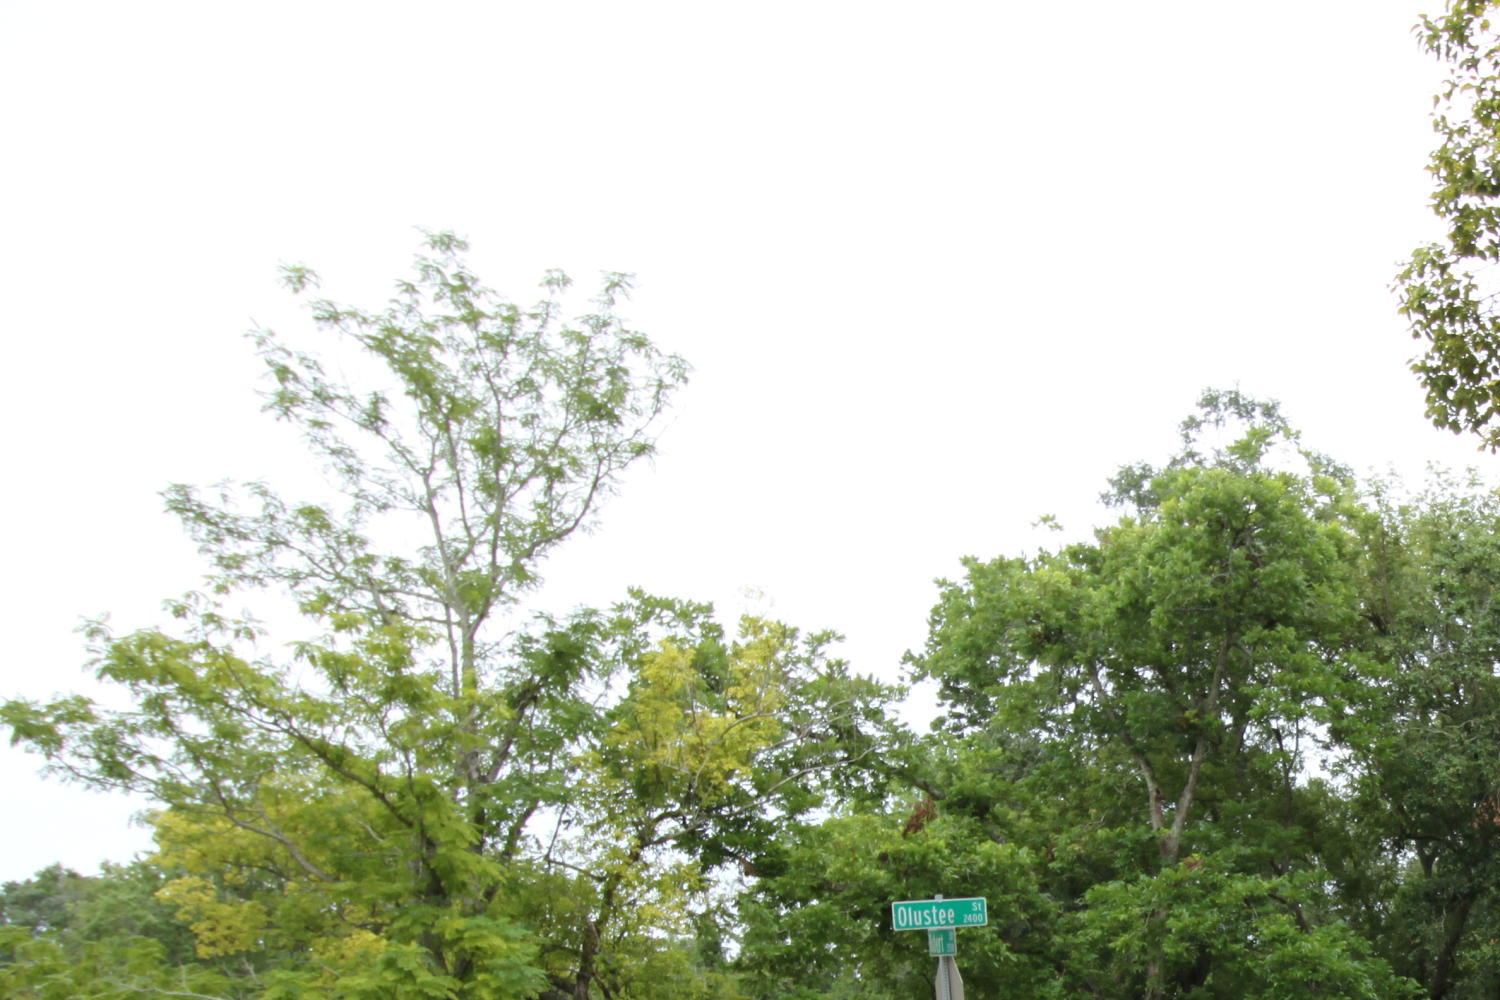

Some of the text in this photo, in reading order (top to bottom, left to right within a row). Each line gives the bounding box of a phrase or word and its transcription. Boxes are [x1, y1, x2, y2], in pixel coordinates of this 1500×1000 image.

[898, 902, 982, 927] Olustee St
[963, 913, 983, 923] 2400
